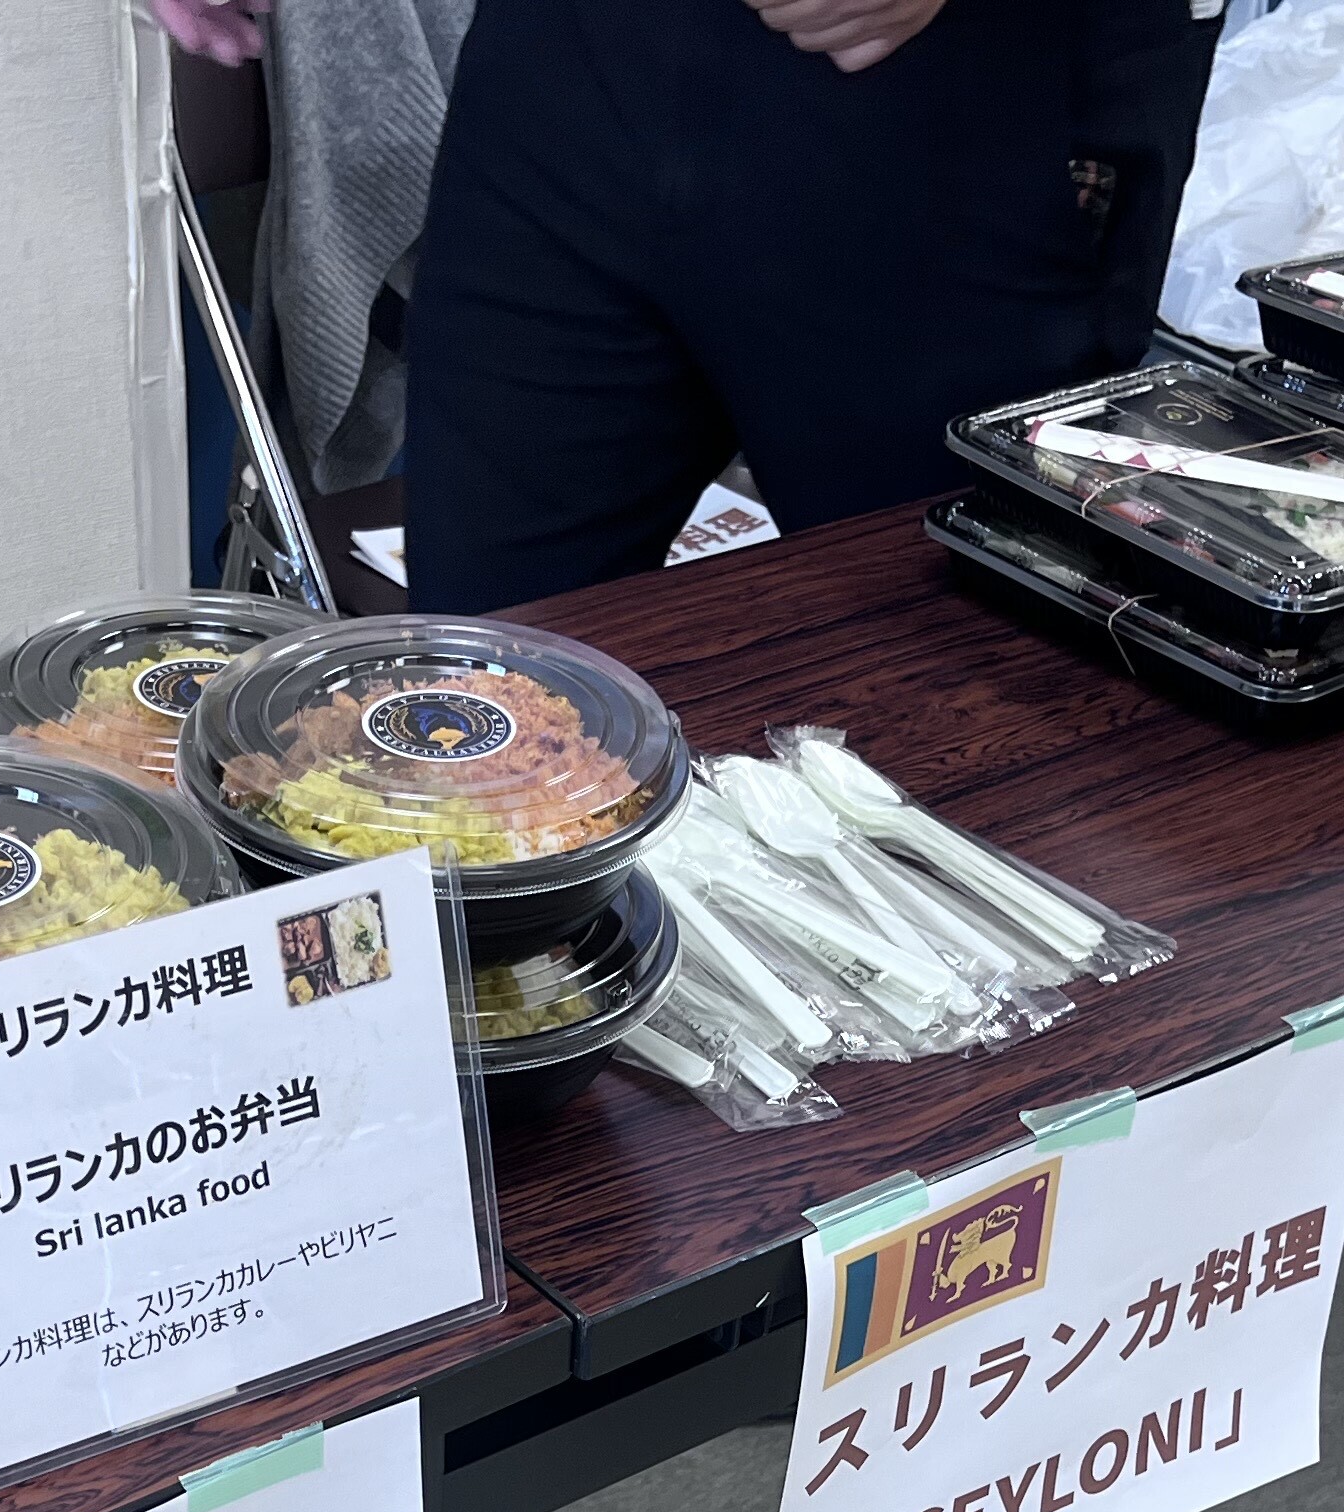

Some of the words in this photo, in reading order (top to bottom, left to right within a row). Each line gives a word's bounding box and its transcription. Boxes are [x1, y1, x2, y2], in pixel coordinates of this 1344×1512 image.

[35, 1218, 83, 1257] Sri
[94, 1193, 187, 1239] lanka
[197, 1160, 270, 1207] food
[102, 1299, 264, 1368] などがあります。
[805, 1205, 1327, 1496] スリランカ料理
